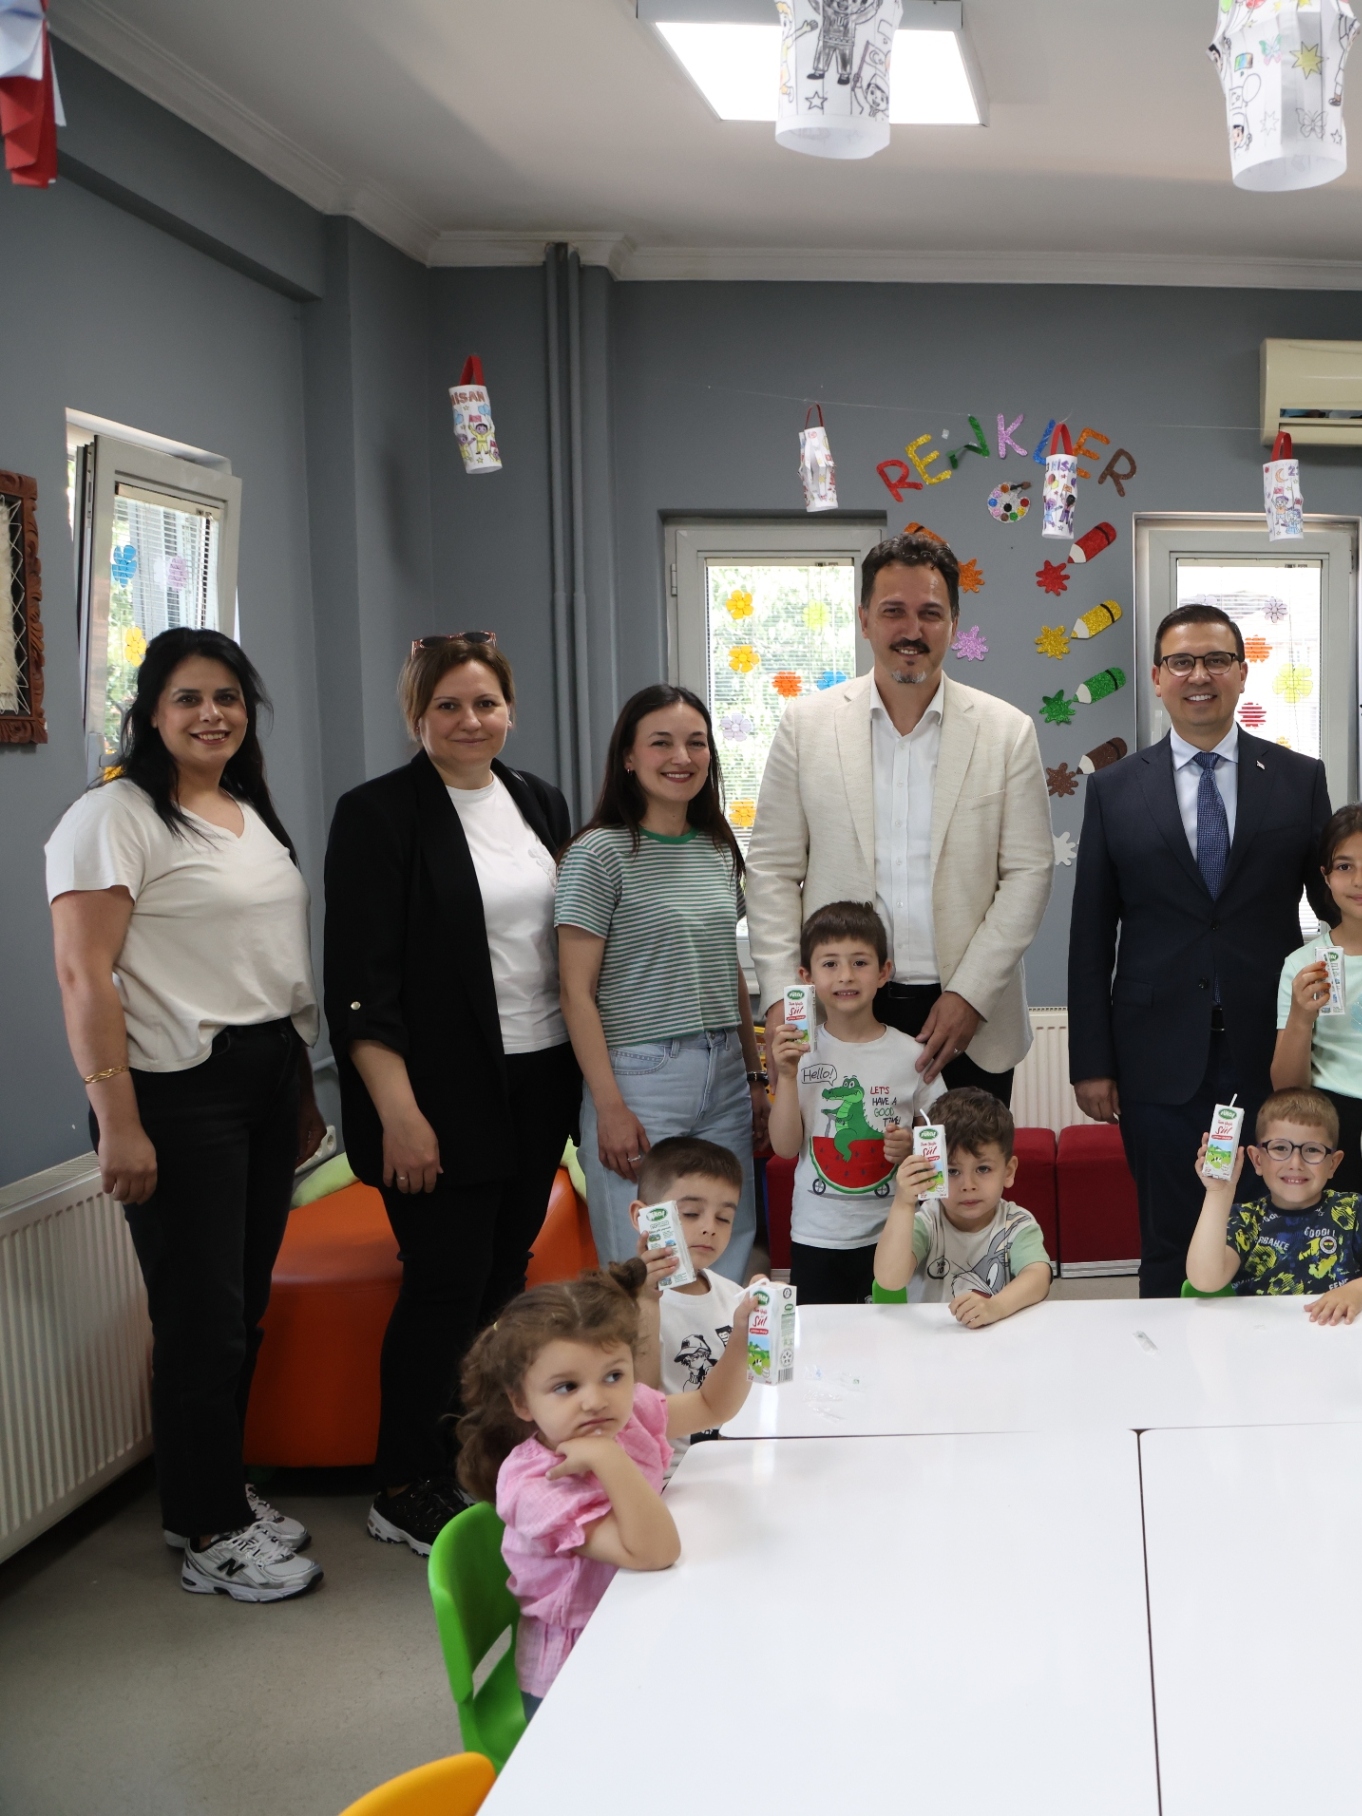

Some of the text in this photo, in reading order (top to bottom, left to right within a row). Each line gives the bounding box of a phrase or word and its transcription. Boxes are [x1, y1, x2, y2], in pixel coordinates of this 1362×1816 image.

[803, 1067, 834, 1082] Hello!
[870, 1086, 890, 1095] LET'S
[872, 1097, 897, 1106] HAVE A
[874, 1107, 894, 1117] GOOD
